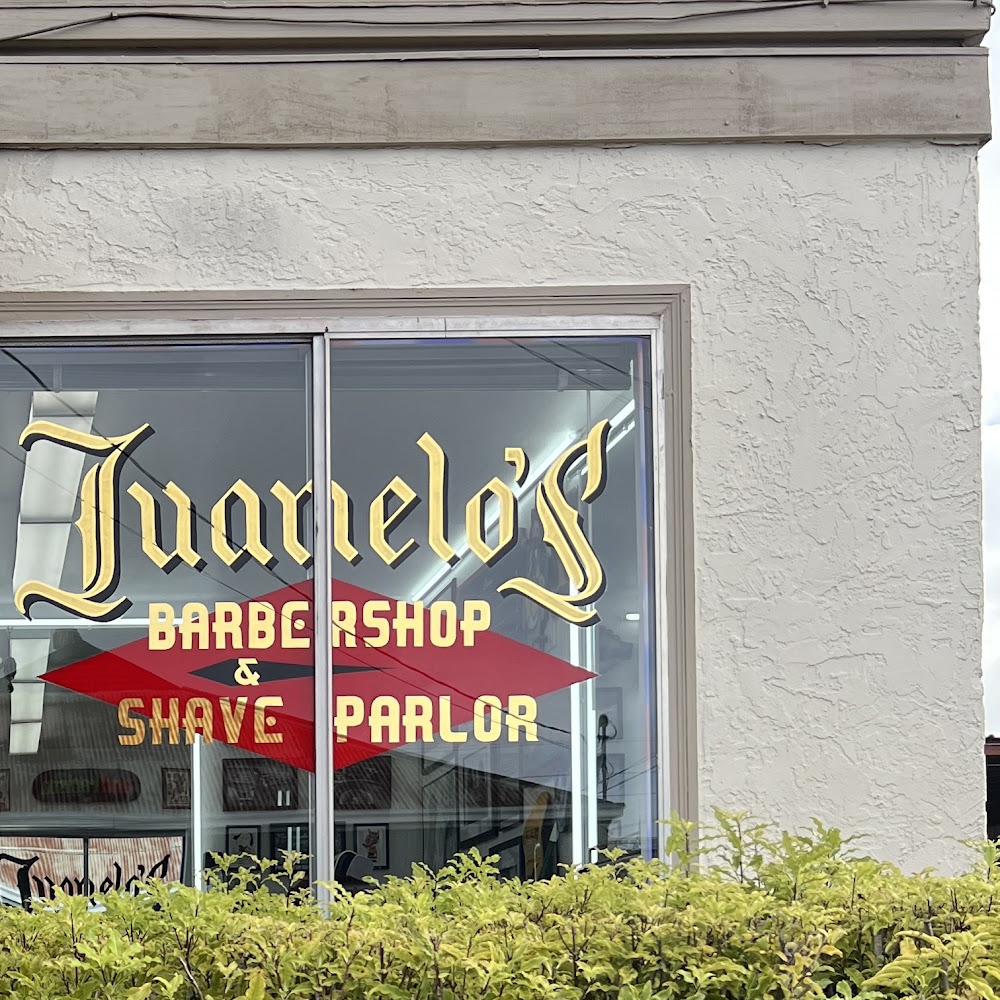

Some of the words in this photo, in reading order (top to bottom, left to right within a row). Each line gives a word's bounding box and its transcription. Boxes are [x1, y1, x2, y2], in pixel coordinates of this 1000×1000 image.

[148, 600, 492, 650] BARBERSHOP
[233, 658, 260, 687] &
[117, 695, 284, 746] SHAVE
[335, 694, 539, 743] PARLOR
